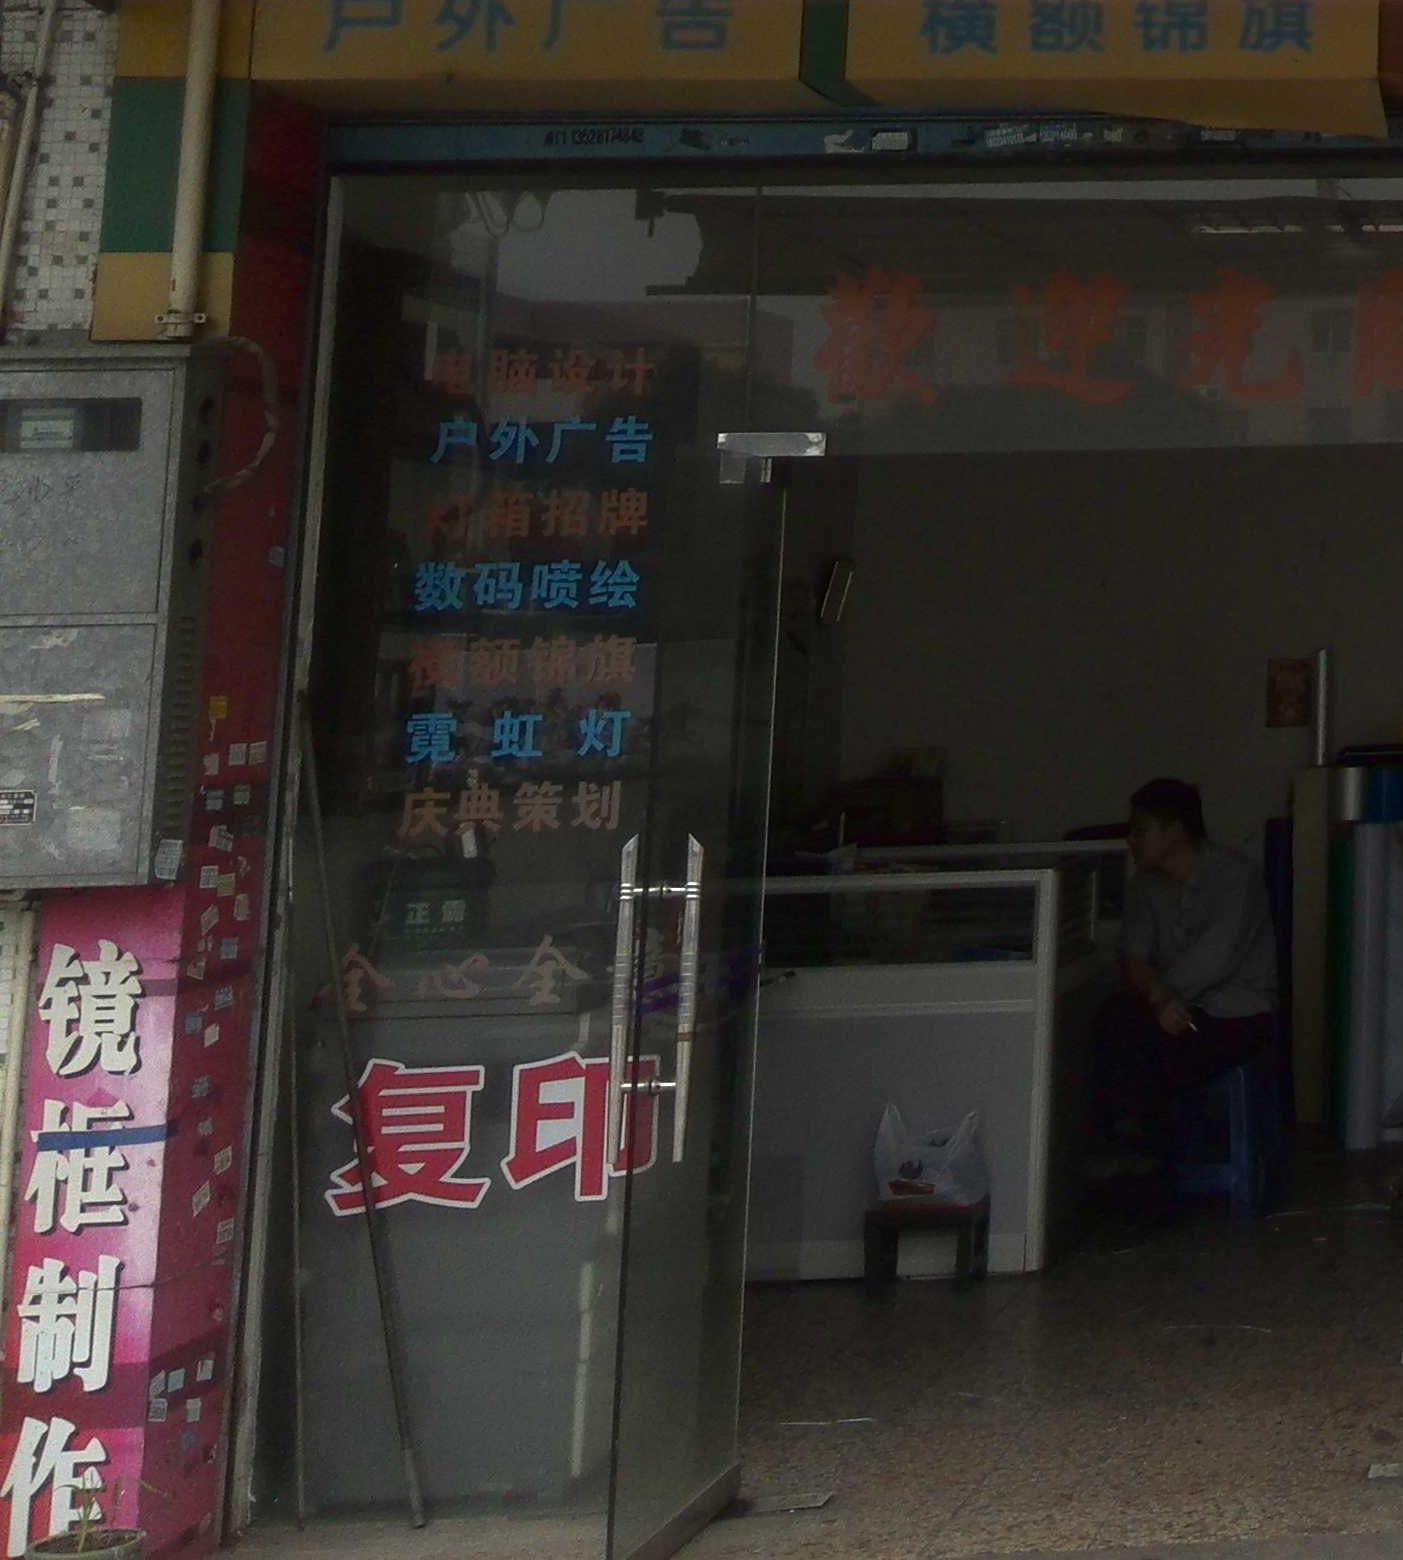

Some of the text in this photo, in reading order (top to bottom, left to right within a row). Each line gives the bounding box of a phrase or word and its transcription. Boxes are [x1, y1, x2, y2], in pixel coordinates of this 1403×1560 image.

[428, 415, 655, 465] 户外广告
[413, 559, 641, 612] 数码喷绘
[404, 708, 632, 765] 霓虹灯
[398, 779, 622, 839] 庆典策划
[325, 1050, 661, 1218] 复印
[2, 938, 144, 1558] 镜框制作
